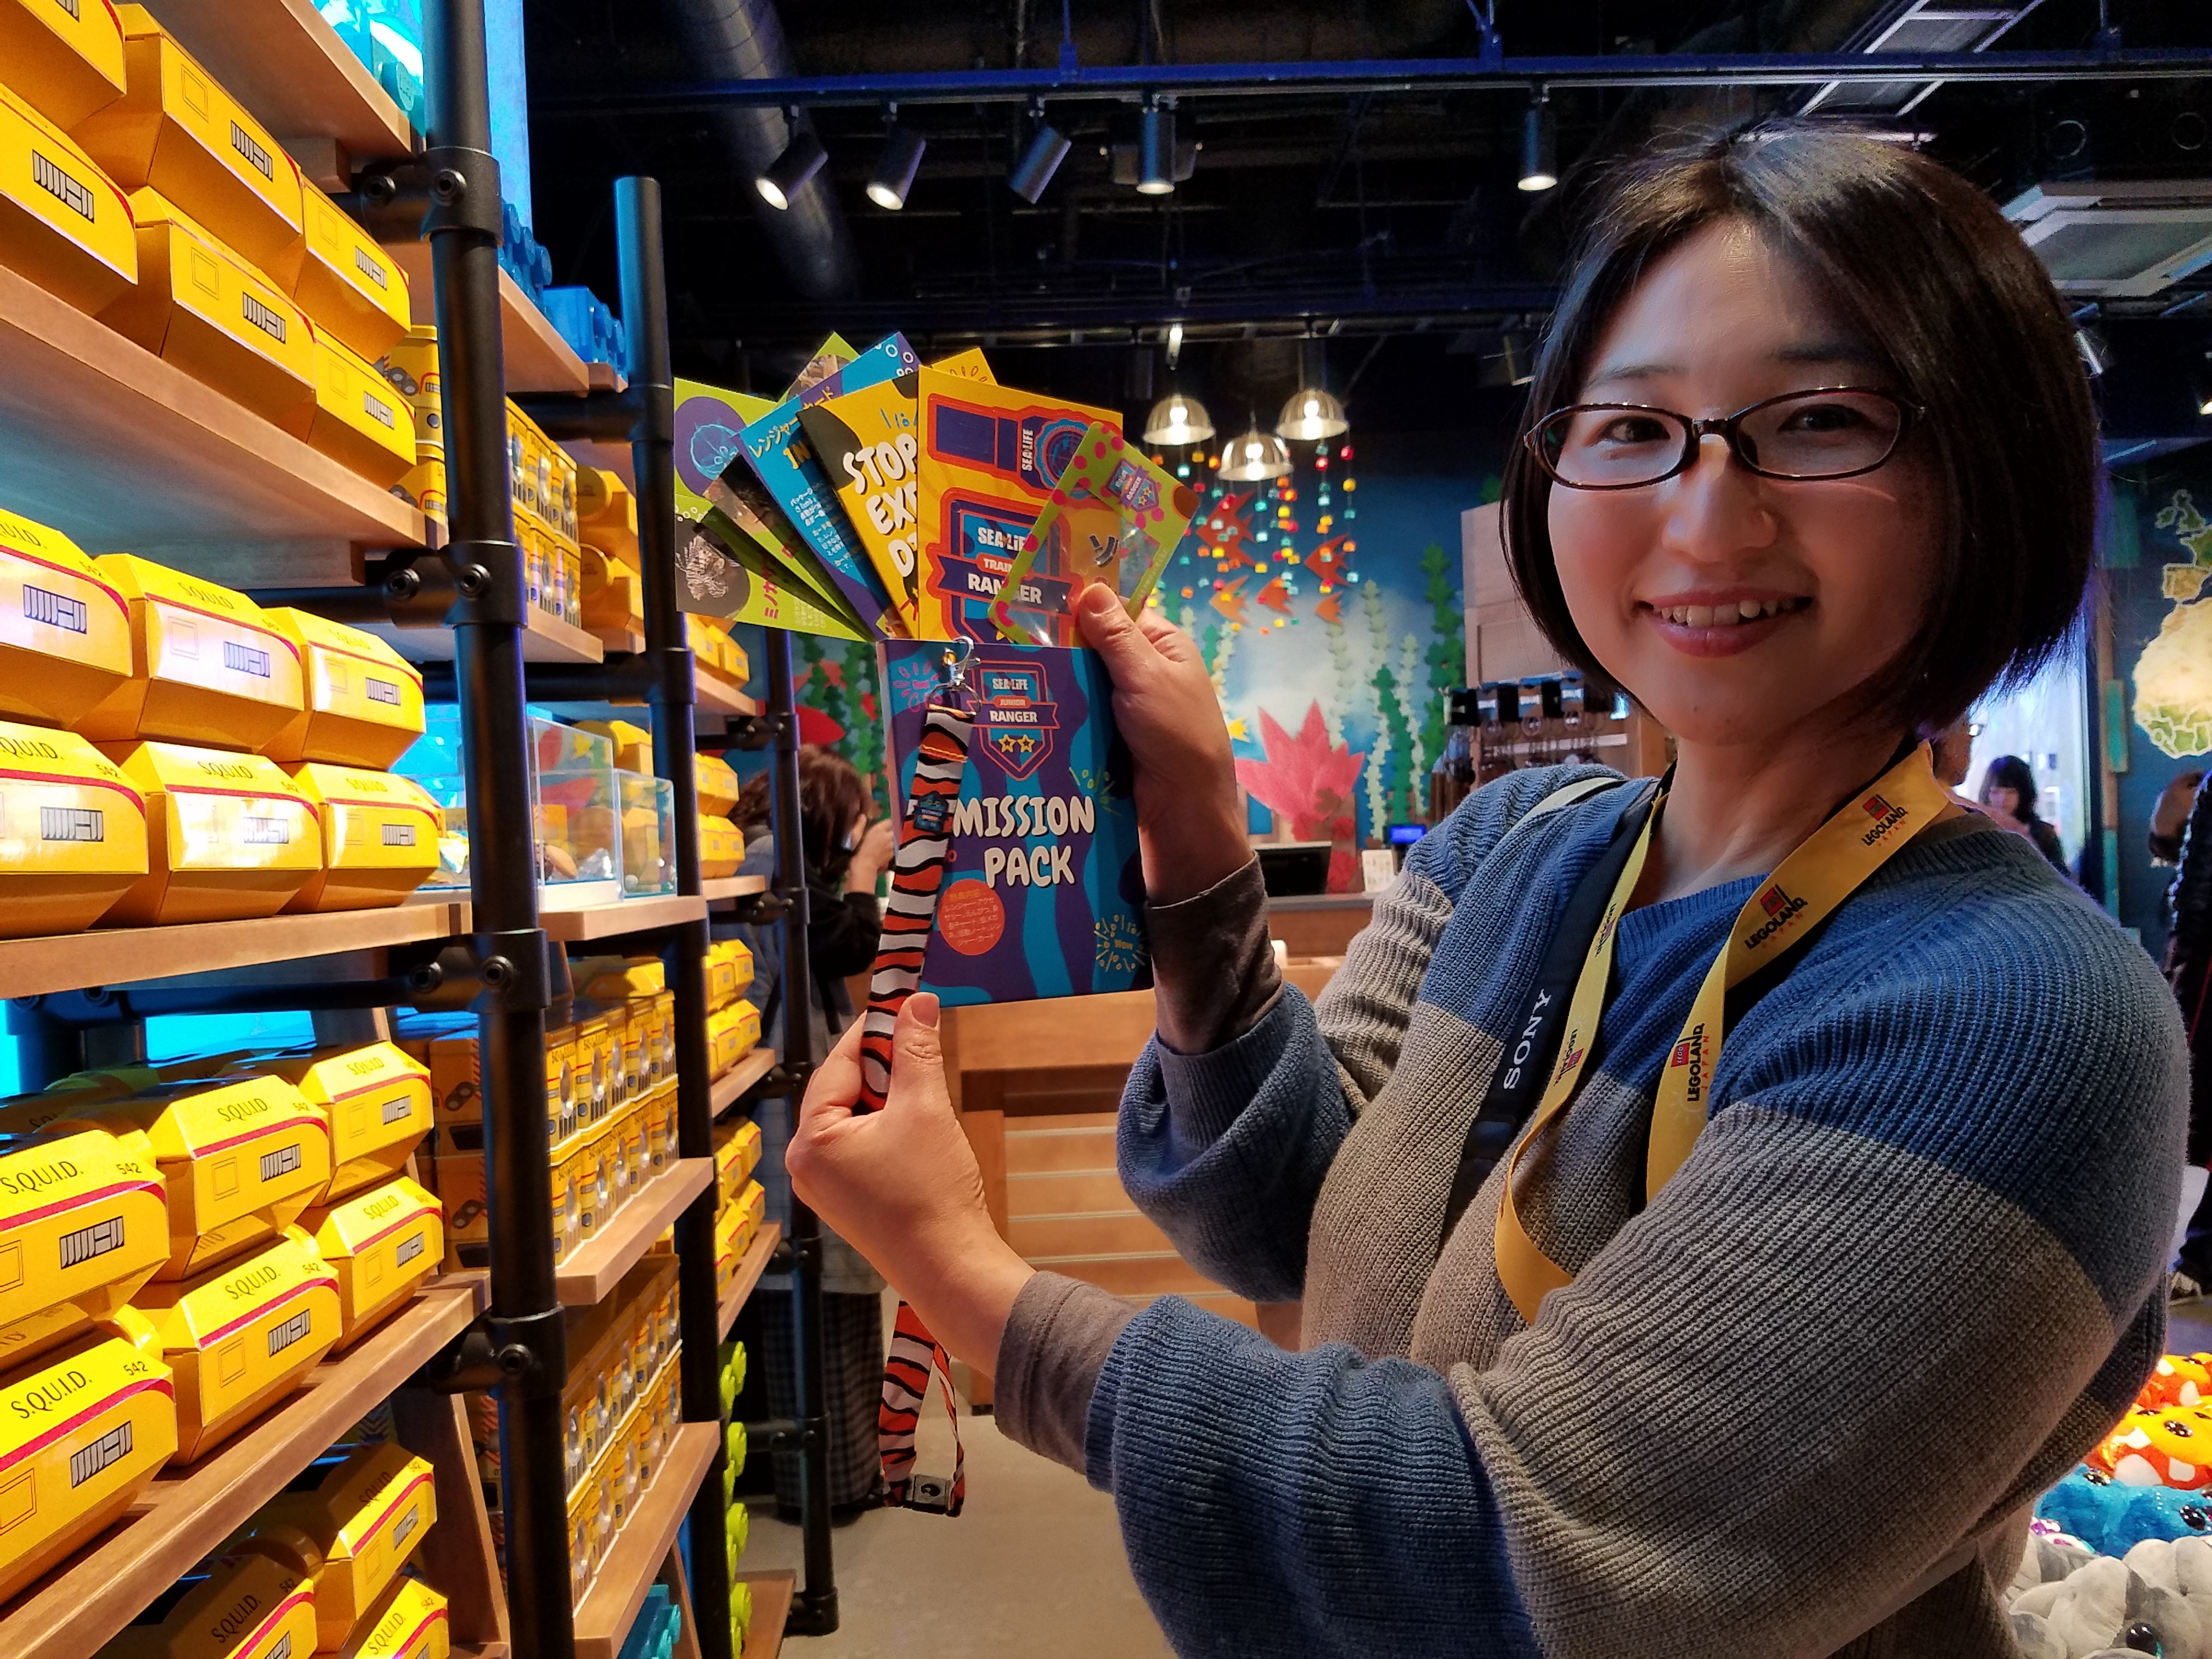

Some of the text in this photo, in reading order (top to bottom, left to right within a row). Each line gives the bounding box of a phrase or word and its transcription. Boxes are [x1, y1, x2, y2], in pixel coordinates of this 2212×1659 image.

[843, 433, 917, 494] STOP
[1022, 452, 1033, 471] SEA
[978, 527, 1004, 548] SEA
[992, 678, 1010, 690] SEA
[989, 710, 1038, 723] RANGER
[95, 764, 122, 780] 542
[953, 795, 1095, 838] MISSION
[1861, 803, 1908, 846] LEGOLAND
[984, 845, 1075, 889] PACK
[1744, 893, 1808, 950] LEGOLAND
[1503, 989, 1552, 1090] SONY
[1685, 1023, 1706, 1102] LEGOLAND
[1701, 1035, 1709, 1091] JAPAN
[217, 1098, 272, 1122] S.Q.U.I.D.
[1, 1161, 142, 1195] S.Q.U.I.D. 542
[225, 1262, 322, 1300] S.Q.U.I.D. 542
[11, 1361, 149, 1419] S.Q.U.I.D. 542
[211, 1594, 262, 1644] S.Q.U.I.D.
[368, 1612, 407, 1655] S.Q.U.I.D.
